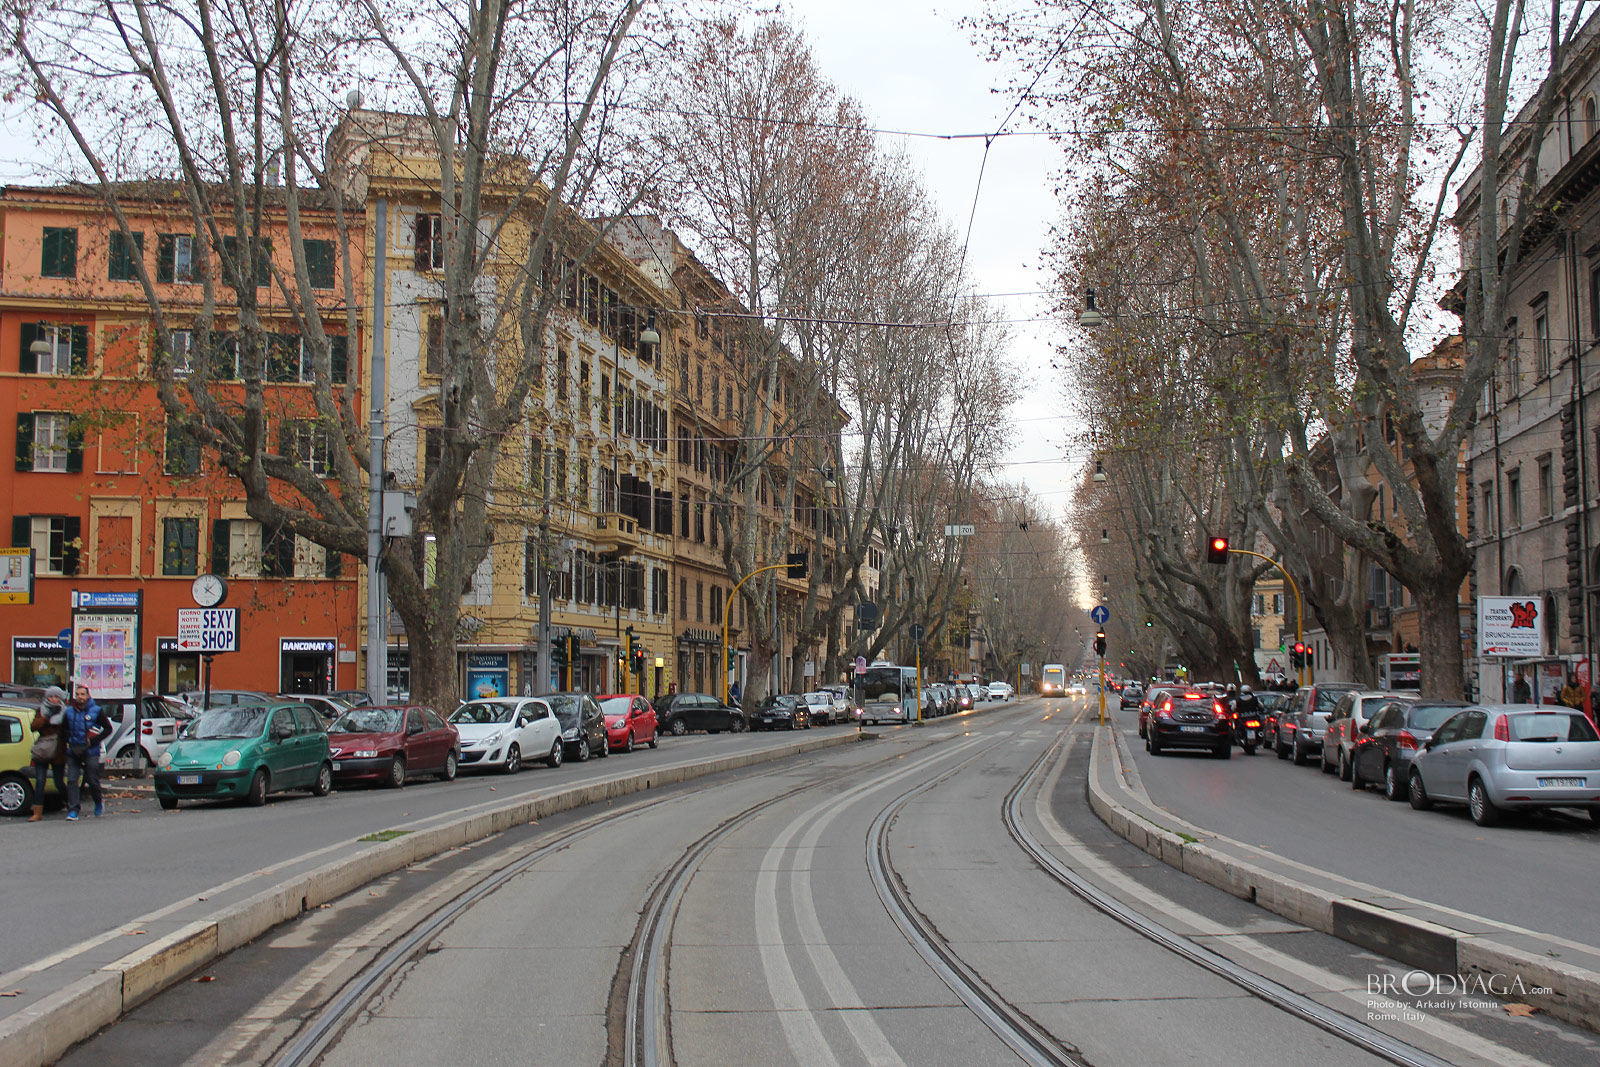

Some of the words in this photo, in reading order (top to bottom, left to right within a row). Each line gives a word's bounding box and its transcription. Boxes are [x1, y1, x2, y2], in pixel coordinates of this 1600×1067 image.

[80, 592, 92, 606] P
[203, 610, 233, 629] SEXY
[201, 630, 233, 649] SHOP
[282, 642, 326, 650] BANCOMAT
